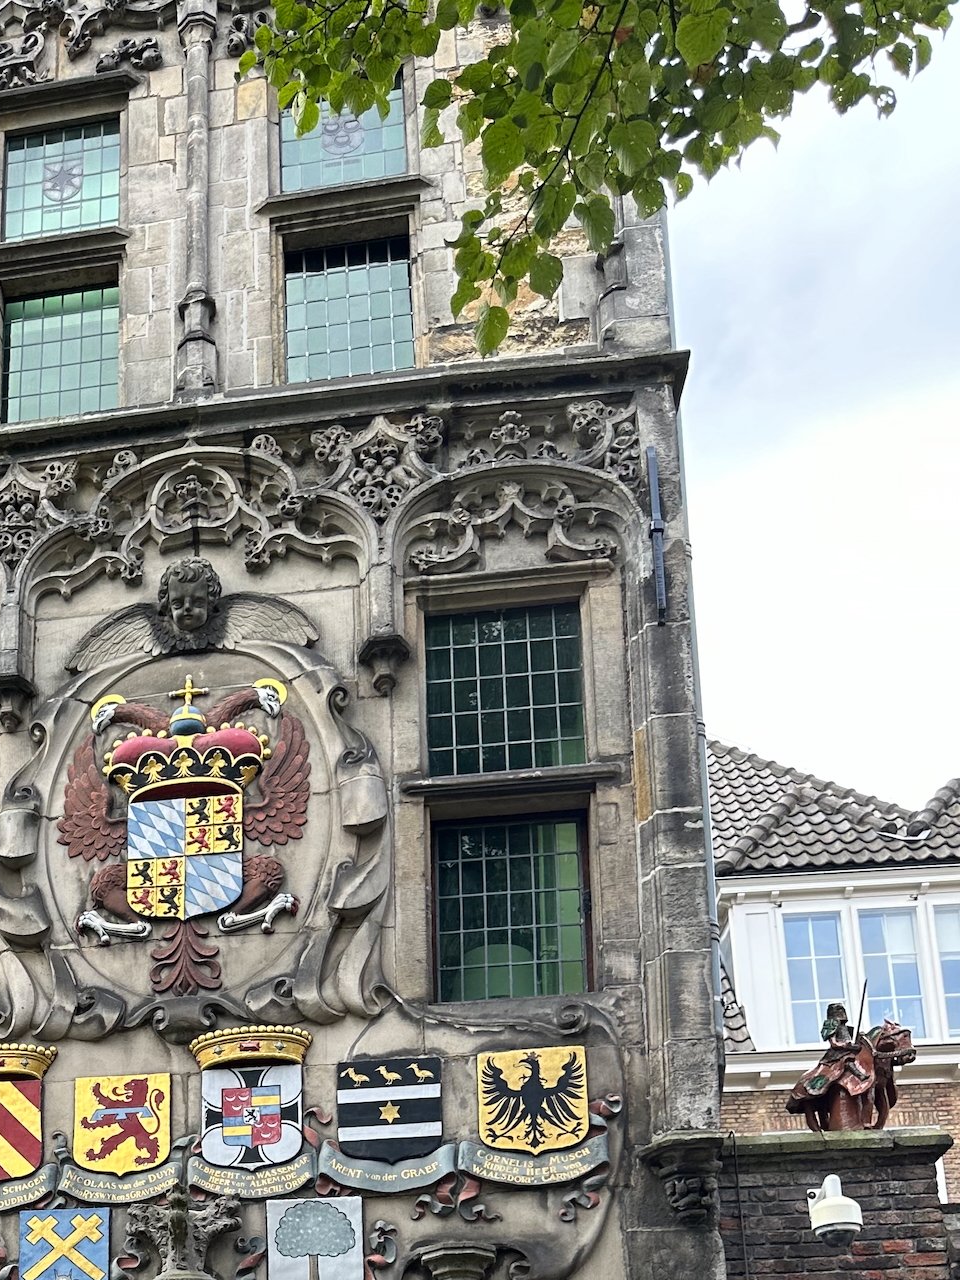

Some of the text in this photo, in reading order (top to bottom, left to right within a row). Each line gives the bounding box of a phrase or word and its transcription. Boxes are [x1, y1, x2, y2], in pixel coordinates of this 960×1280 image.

[192, 1160, 240, 1180] ALBRECHT
[255, 1156, 309, 1179] WASSENAAR
[476, 1147, 591, 1168] CORNELIS MUSCH
[483, 1160, 520, 1175] RIDDER
[66, 1170, 117, 1190] NICOLAAS
[133, 1180, 146, 1188] der
[147, 1167, 176, 1183] DUYN
[209, 1175, 230, 1186] HEER
[249, 1172, 297, 1188] ALKEMADE
[328, 1158, 364, 1179] ARENT
[365, 1172, 381, 1180] van
[382, 1173, 398, 1181] der
[2, 1173, 47, 1195] SCHAGEN
[192, 1174, 221, 1192] RIDDER
[284, 1171, 311, 1190] ORDER
